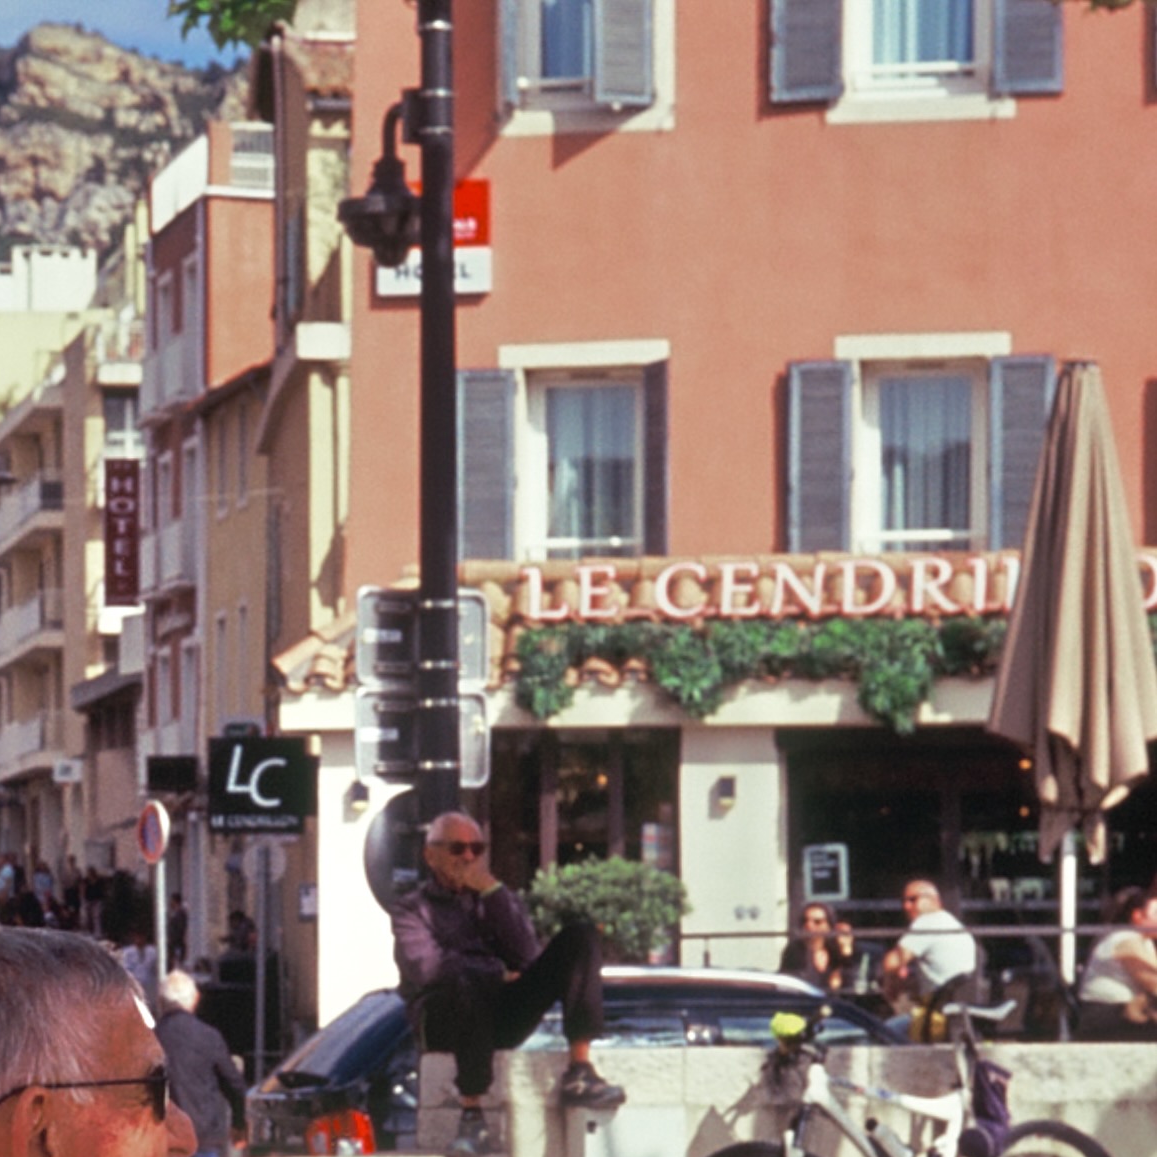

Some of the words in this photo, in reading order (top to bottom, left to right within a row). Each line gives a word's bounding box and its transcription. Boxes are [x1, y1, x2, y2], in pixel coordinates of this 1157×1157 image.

[395, 263, 471, 280] HOL
[110, 477, 135, 576] HOTEL
[521, 564, 618, 620] LE
